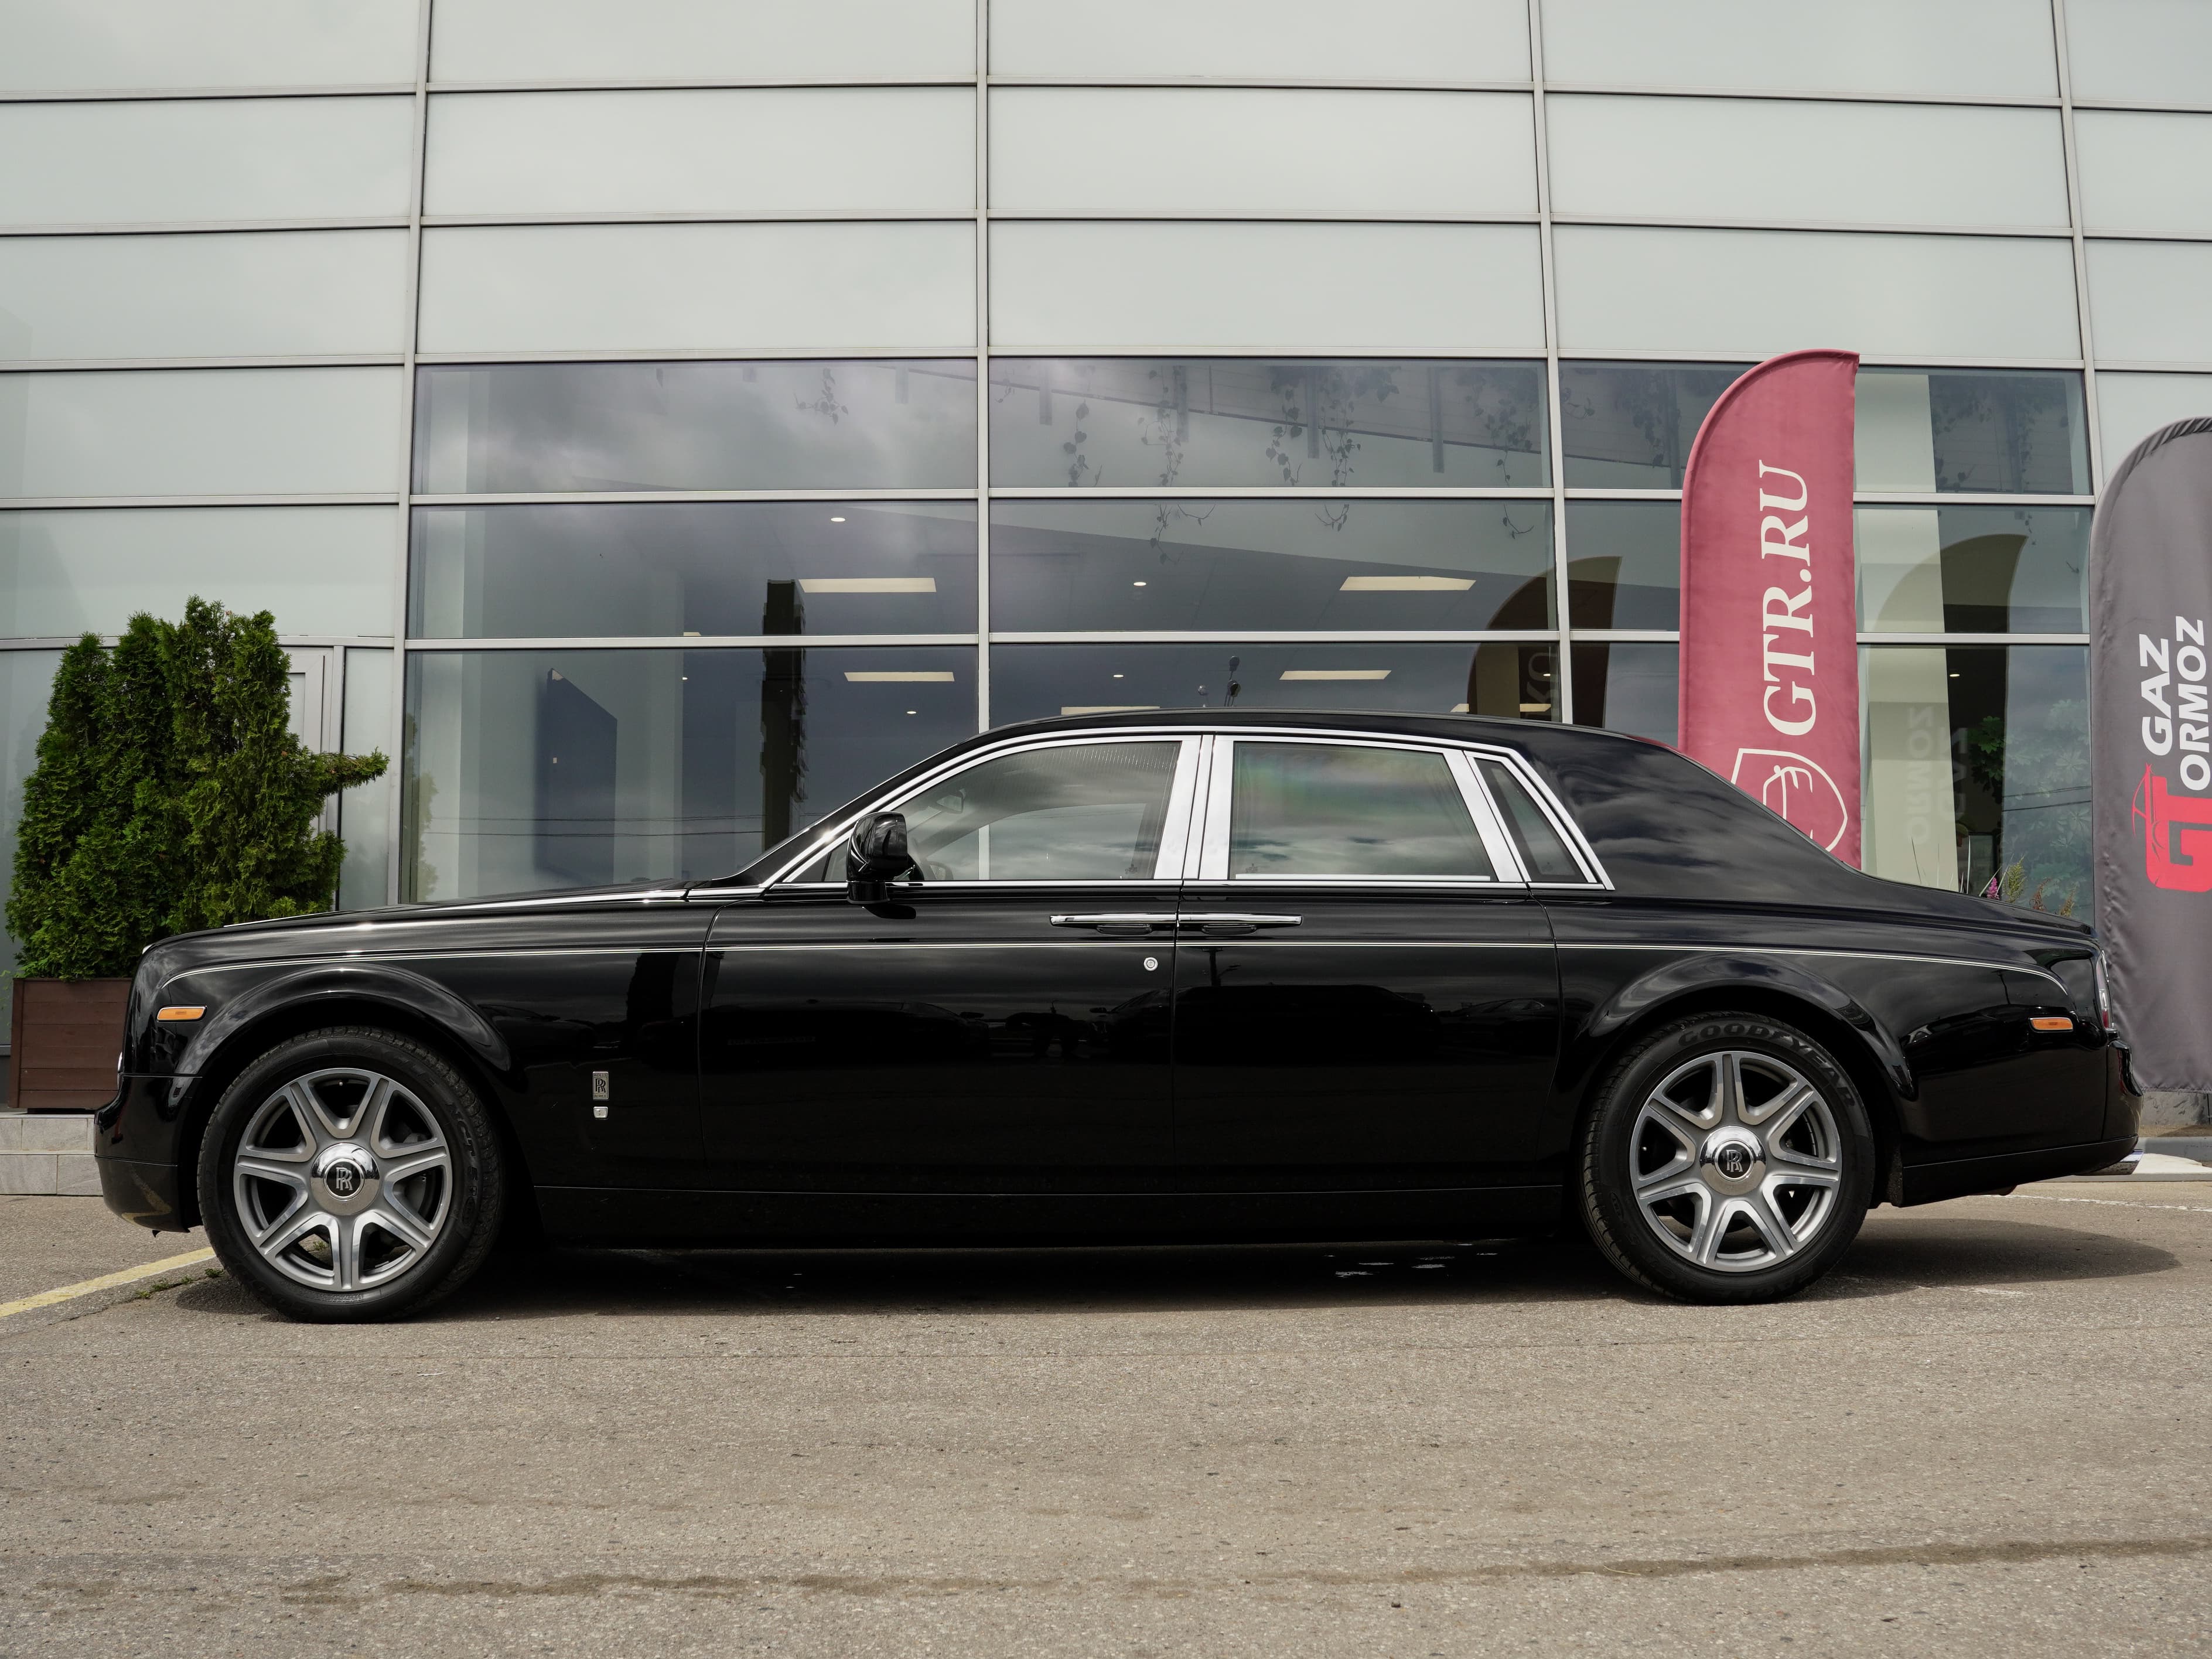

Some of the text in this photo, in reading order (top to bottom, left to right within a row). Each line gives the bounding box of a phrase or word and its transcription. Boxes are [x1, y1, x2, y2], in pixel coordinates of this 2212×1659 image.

[1759, 459, 1817, 737] GTR.RU
[2139, 633, 2173, 756] GAZ
[2175, 615, 2211, 791] ORMOZ
[1678, 1021, 1856, 1108] GOODYEAR
